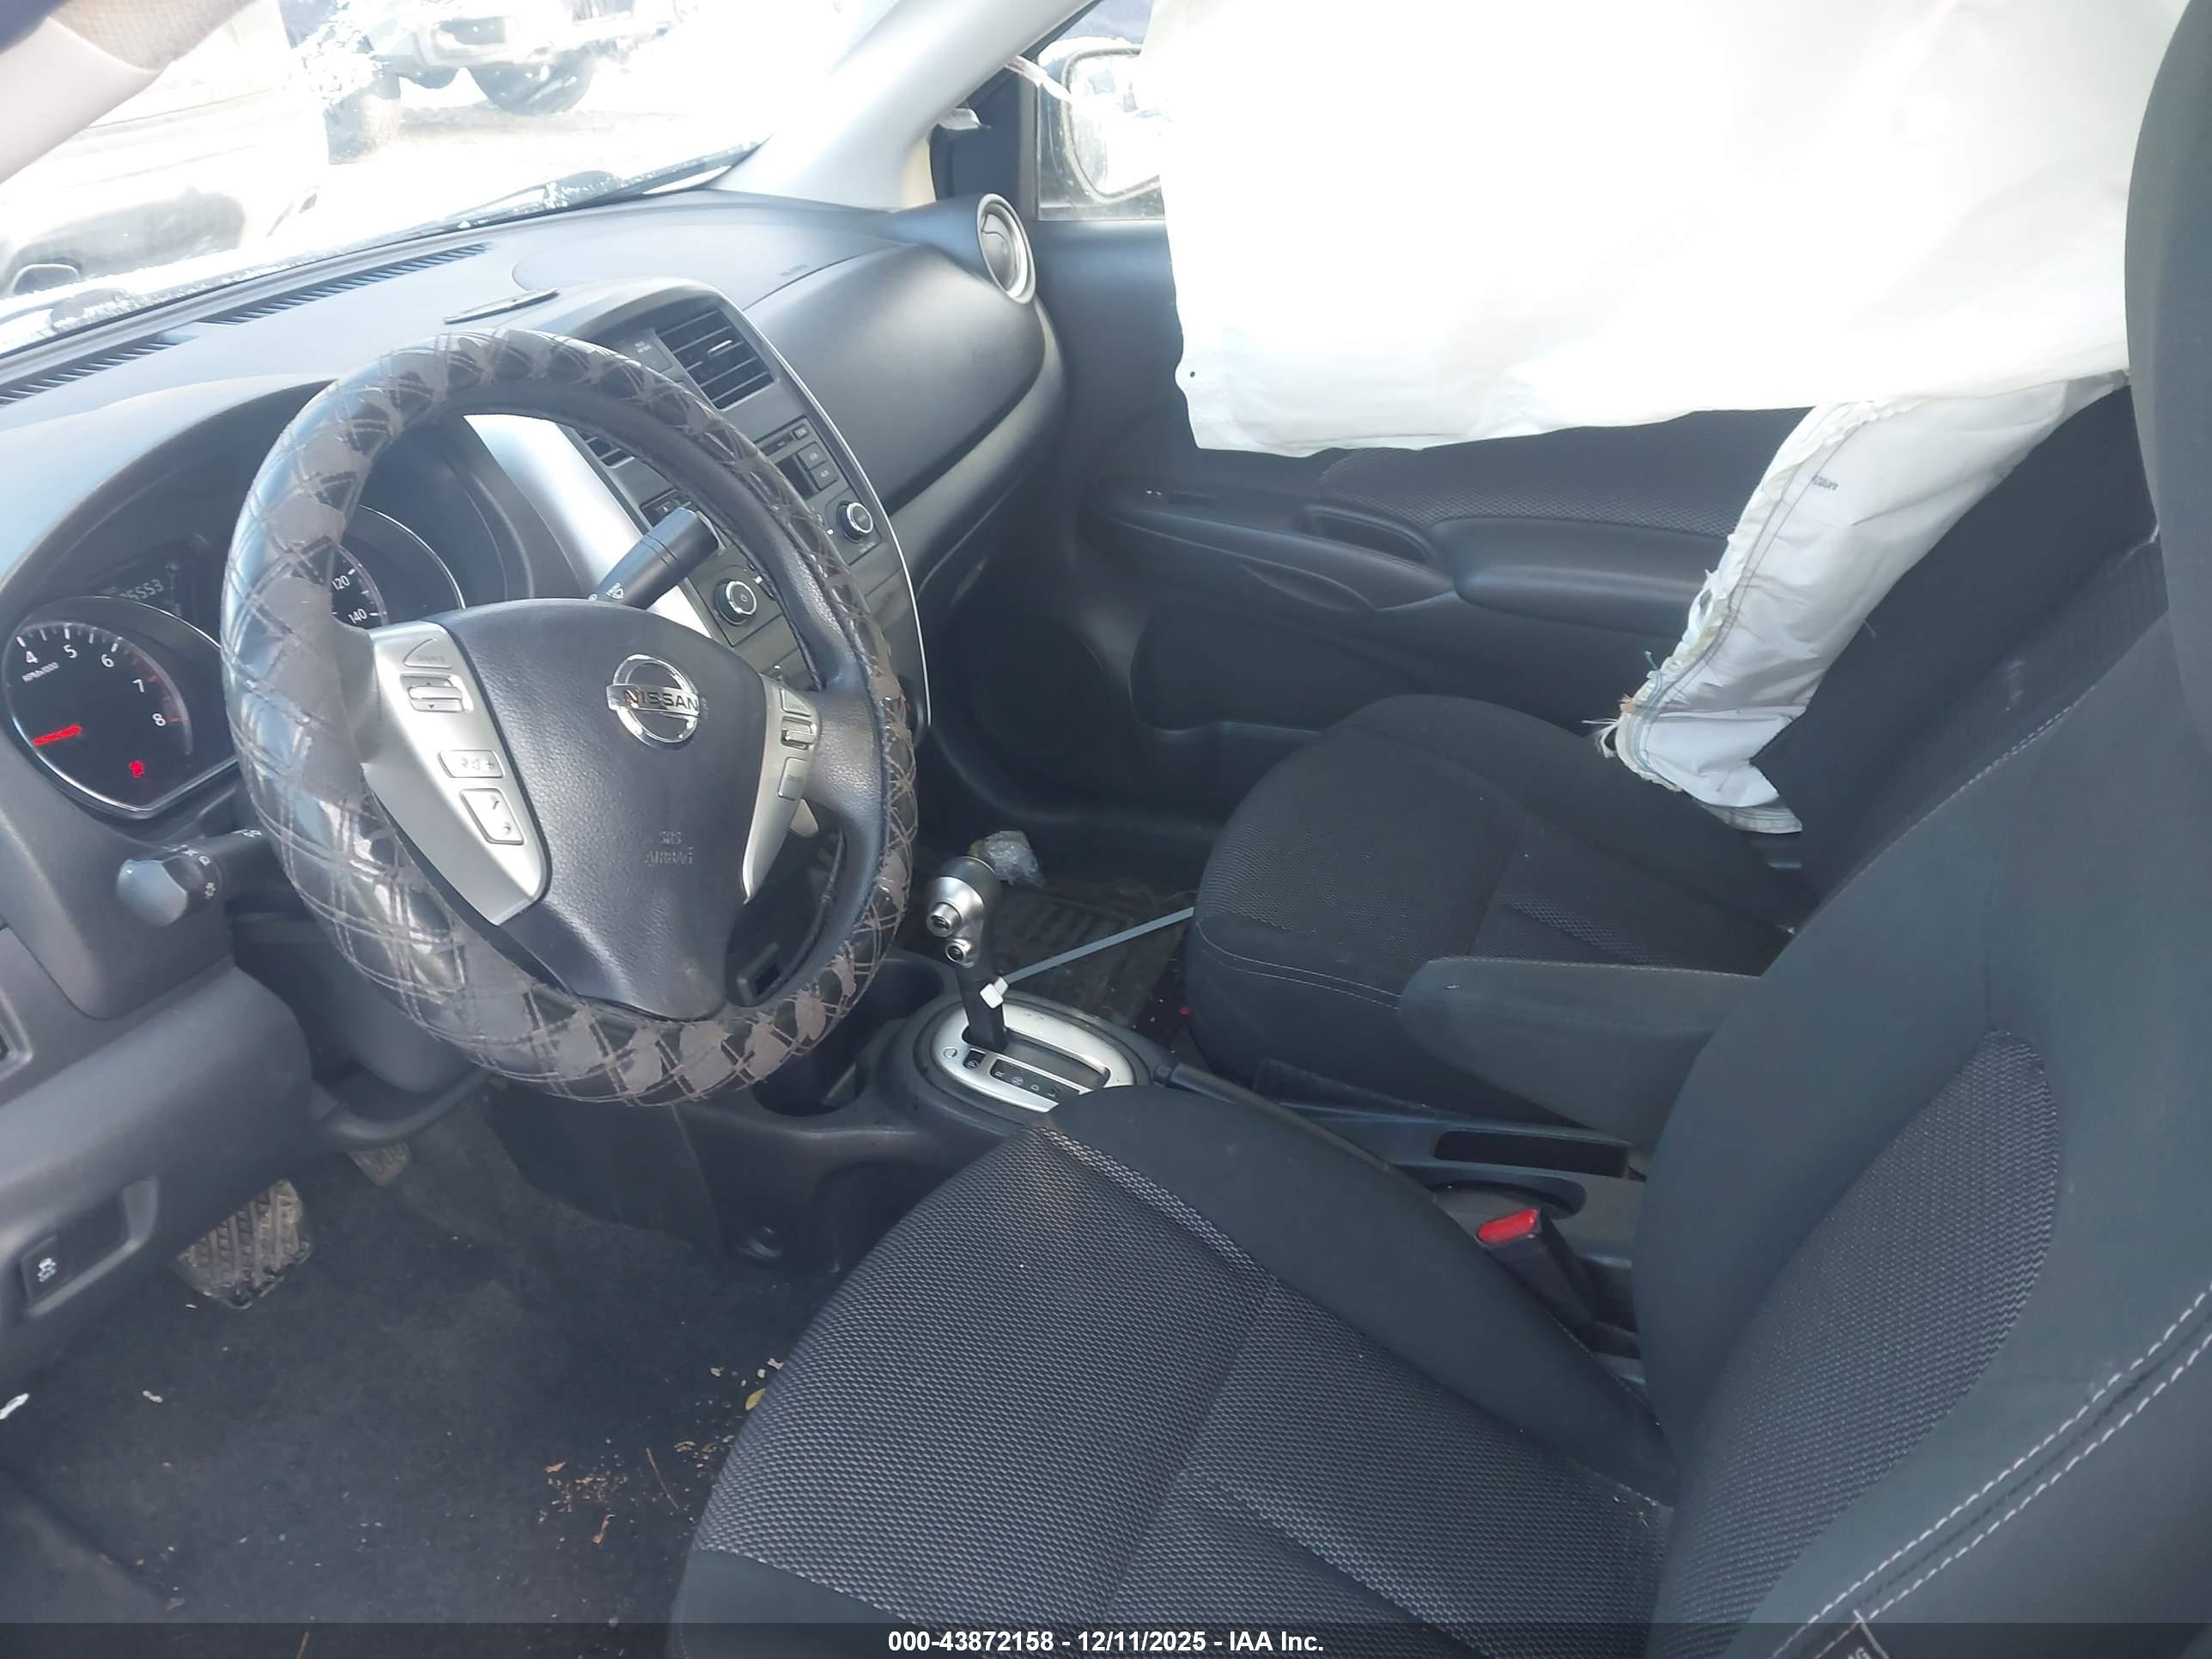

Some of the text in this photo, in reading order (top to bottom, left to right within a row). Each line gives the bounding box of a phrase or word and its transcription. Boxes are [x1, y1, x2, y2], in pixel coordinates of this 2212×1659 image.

[331, 574, 350, 591] 120
[348, 608, 368, 624] 140
[26, 651, 39, 664] 4
[63, 644, 77, 659] 5
[100, 653, 115, 668] 6
[131, 678, 145, 693] 7
[624, 690, 698, 711] NISSAN
[152, 713, 166, 726] 8
